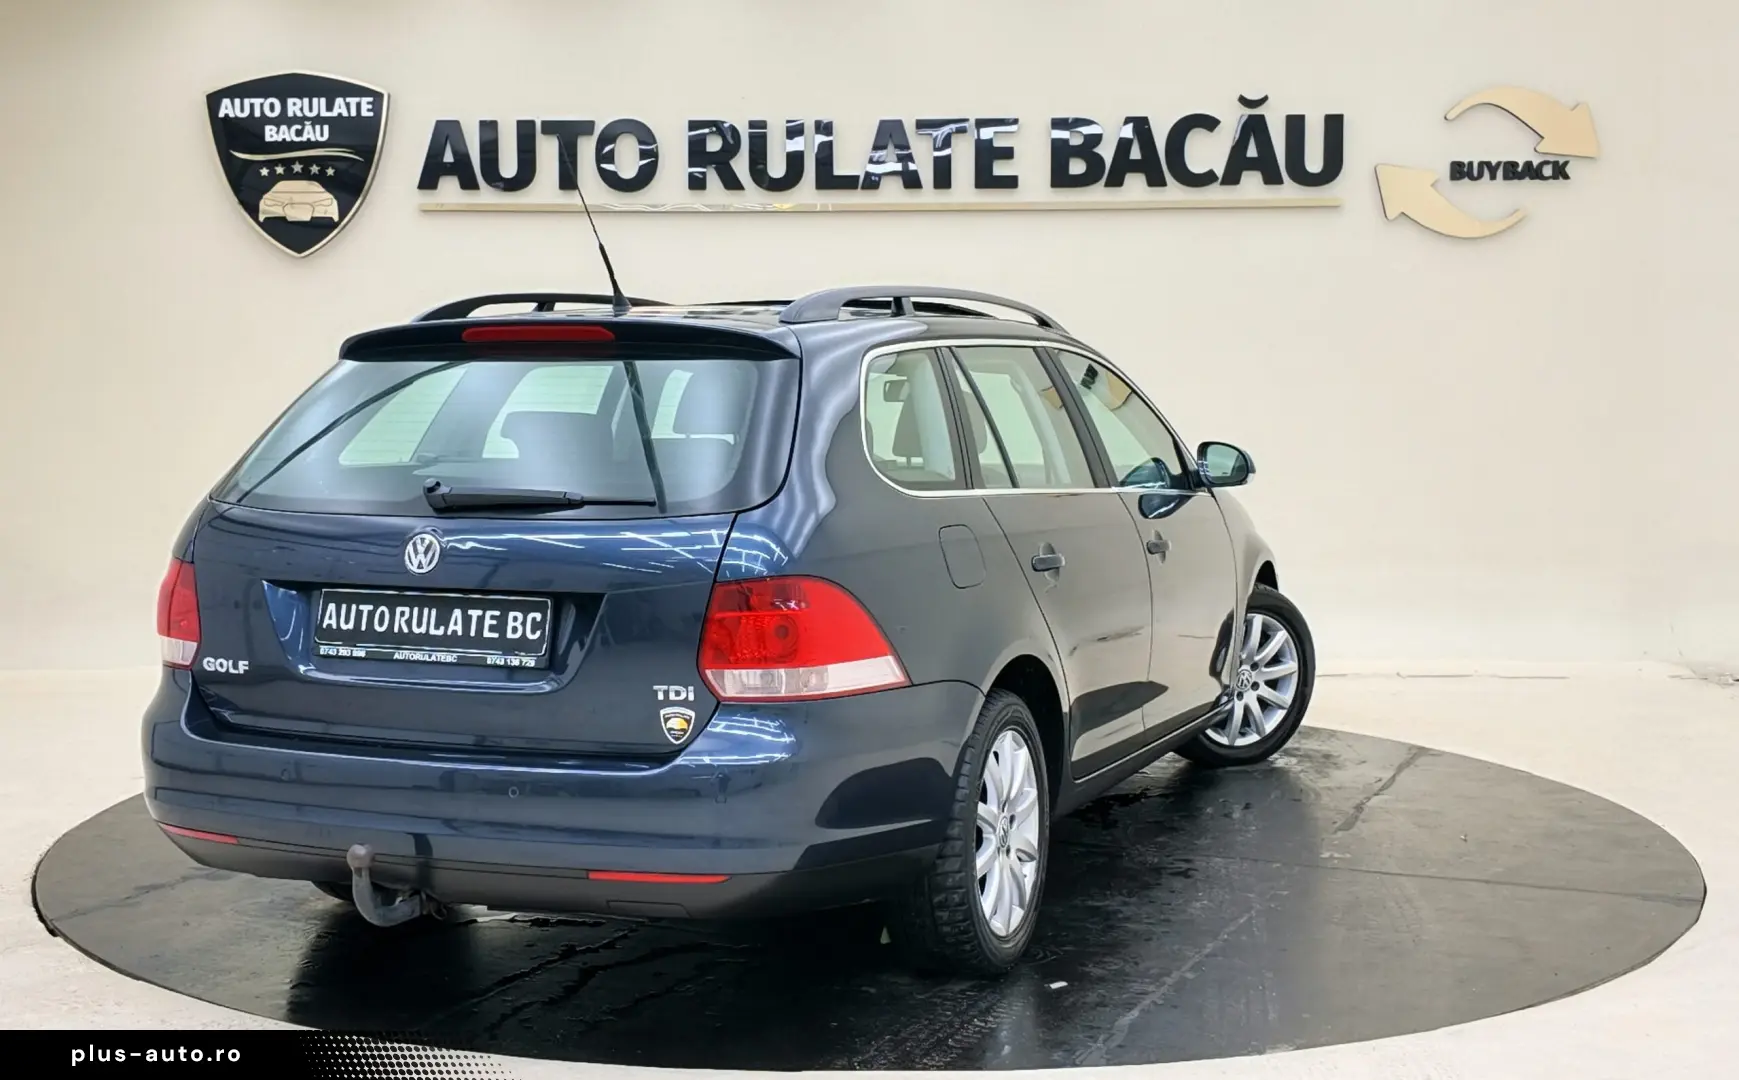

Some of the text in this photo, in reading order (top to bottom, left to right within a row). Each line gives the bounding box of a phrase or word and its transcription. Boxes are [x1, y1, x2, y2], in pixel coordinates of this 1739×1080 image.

[218, 96, 374, 118] AUTO RULATE
[264, 120, 330, 143] BACĂU
[417, 94, 1345, 193] AUTO RULATE BACĂU
[1449, 159, 1571, 182] BUYBACK
[506, 611, 542, 640] BC
[202, 656, 249, 674] GOLF
[393, 650, 458, 663] AUTORULATEBC
[652, 685, 695, 702] TDI
